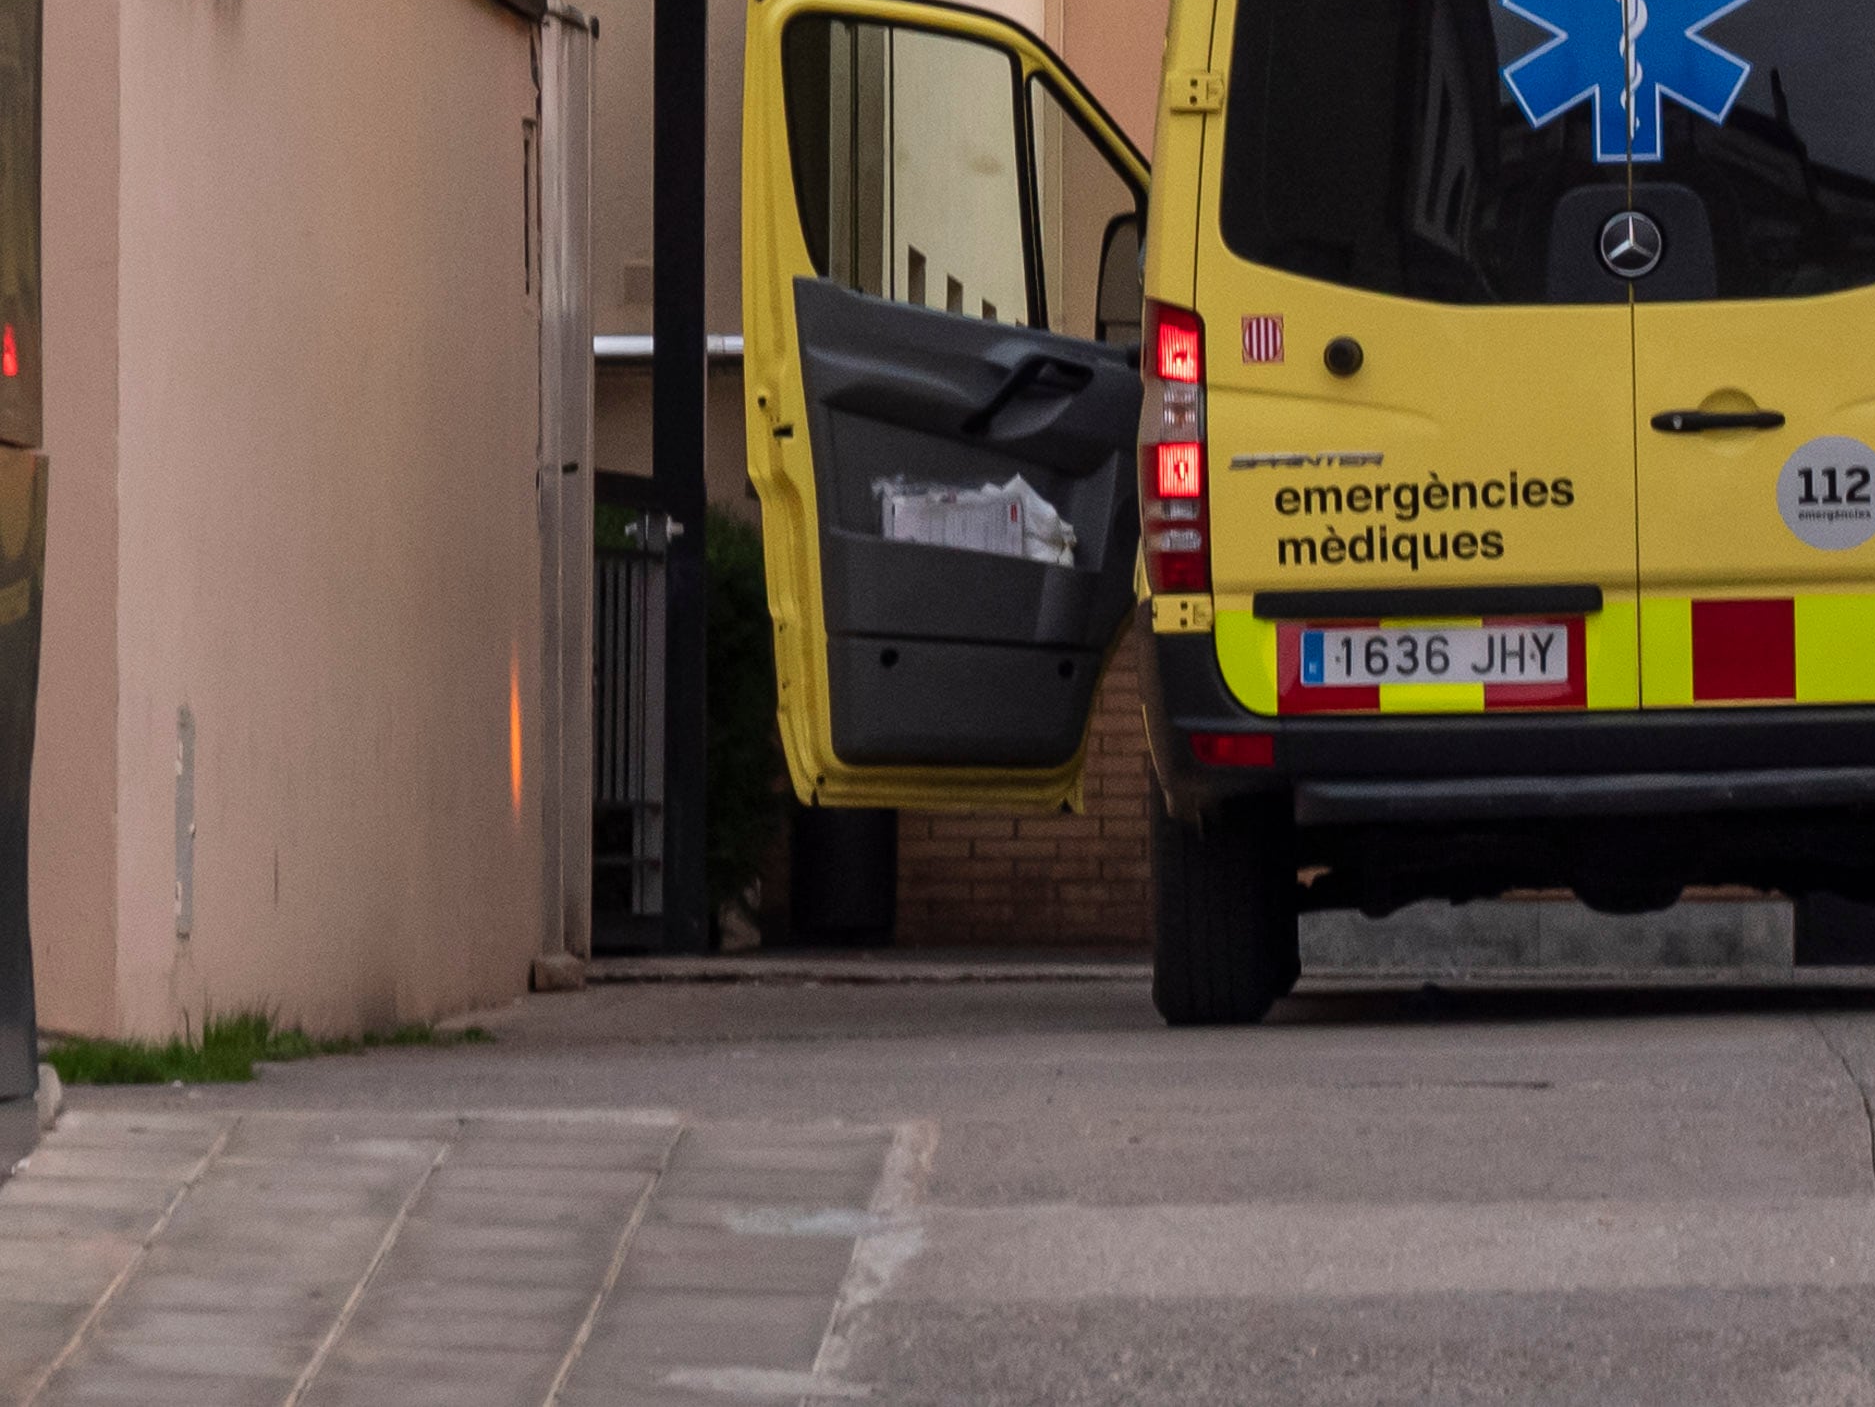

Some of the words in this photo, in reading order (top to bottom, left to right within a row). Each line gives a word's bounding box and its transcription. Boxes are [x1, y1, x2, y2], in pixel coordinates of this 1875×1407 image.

[1274, 470, 1576, 522] emergències
[1797, 467, 1871, 507] 112
[1277, 524, 1505, 572] mèdiques
[1340, 635, 1450, 677] 1636
[1471, 632, 1554, 675] JHY
